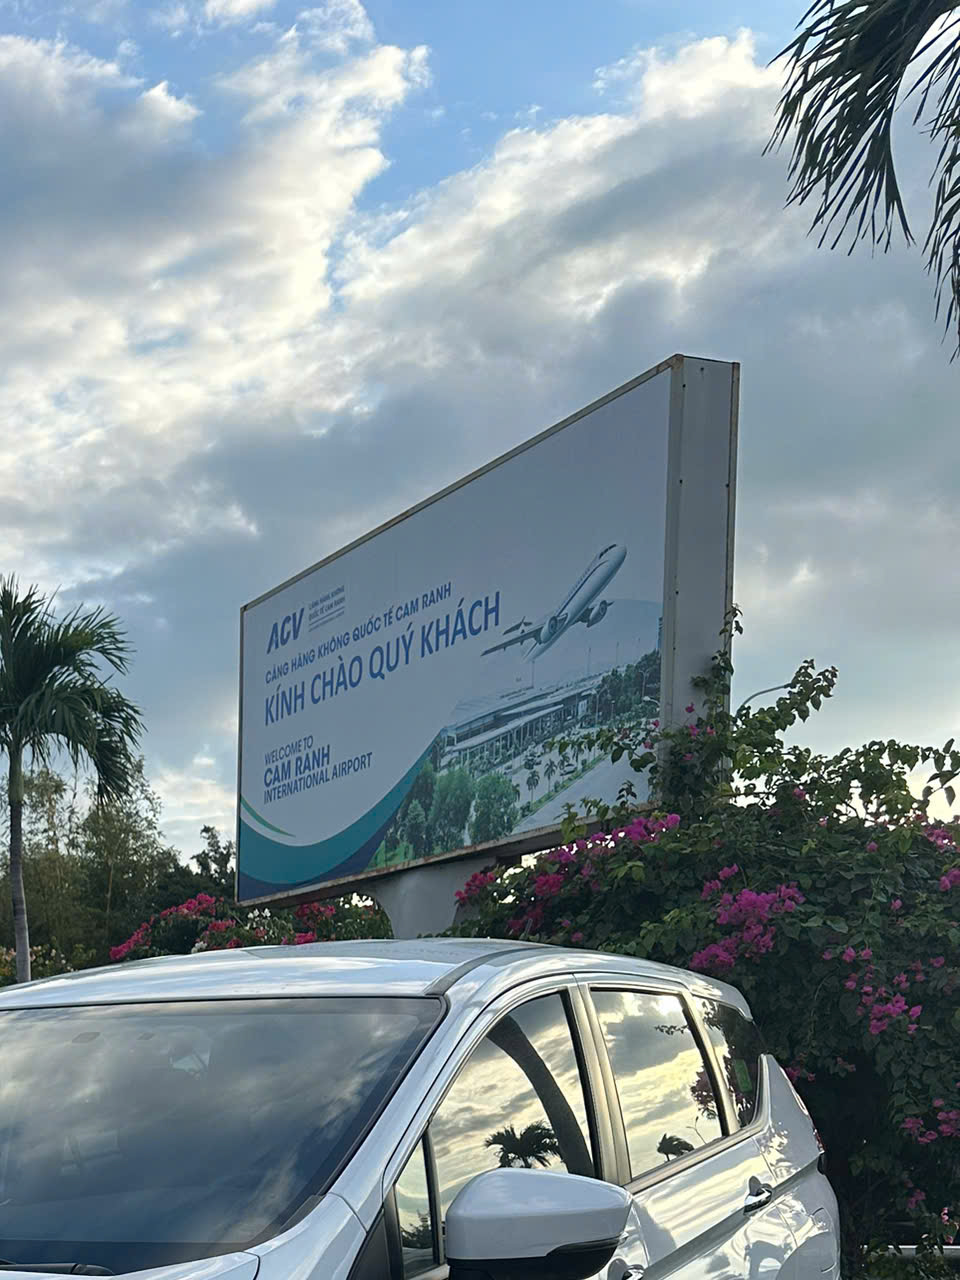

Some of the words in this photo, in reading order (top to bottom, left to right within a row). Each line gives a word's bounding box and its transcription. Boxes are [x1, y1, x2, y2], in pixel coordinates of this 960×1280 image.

[266, 607, 305, 654] ACV
[318, 631, 350, 659] KHÔNG
[352, 615, 381, 642] QUỐC
[384, 605, 394, 628] TẾ
[395, 597, 419, 621] CAM
[422, 582, 451, 610] RANH
[265, 681, 305, 726] KÍNH
[311, 655, 363, 705] CHÀO
[369, 622, 414, 680] QUÝ
[420, 591, 500, 658] KHÁCH
[264, 760, 291, 788] CAM
[295, 744, 330, 777] RANH
[265, 739, 302, 766] WELCOME
[303, 735, 314, 749] TO
[264, 767, 330, 805] INTERNATIONAL
[331, 752, 373, 780] AIRPORT
